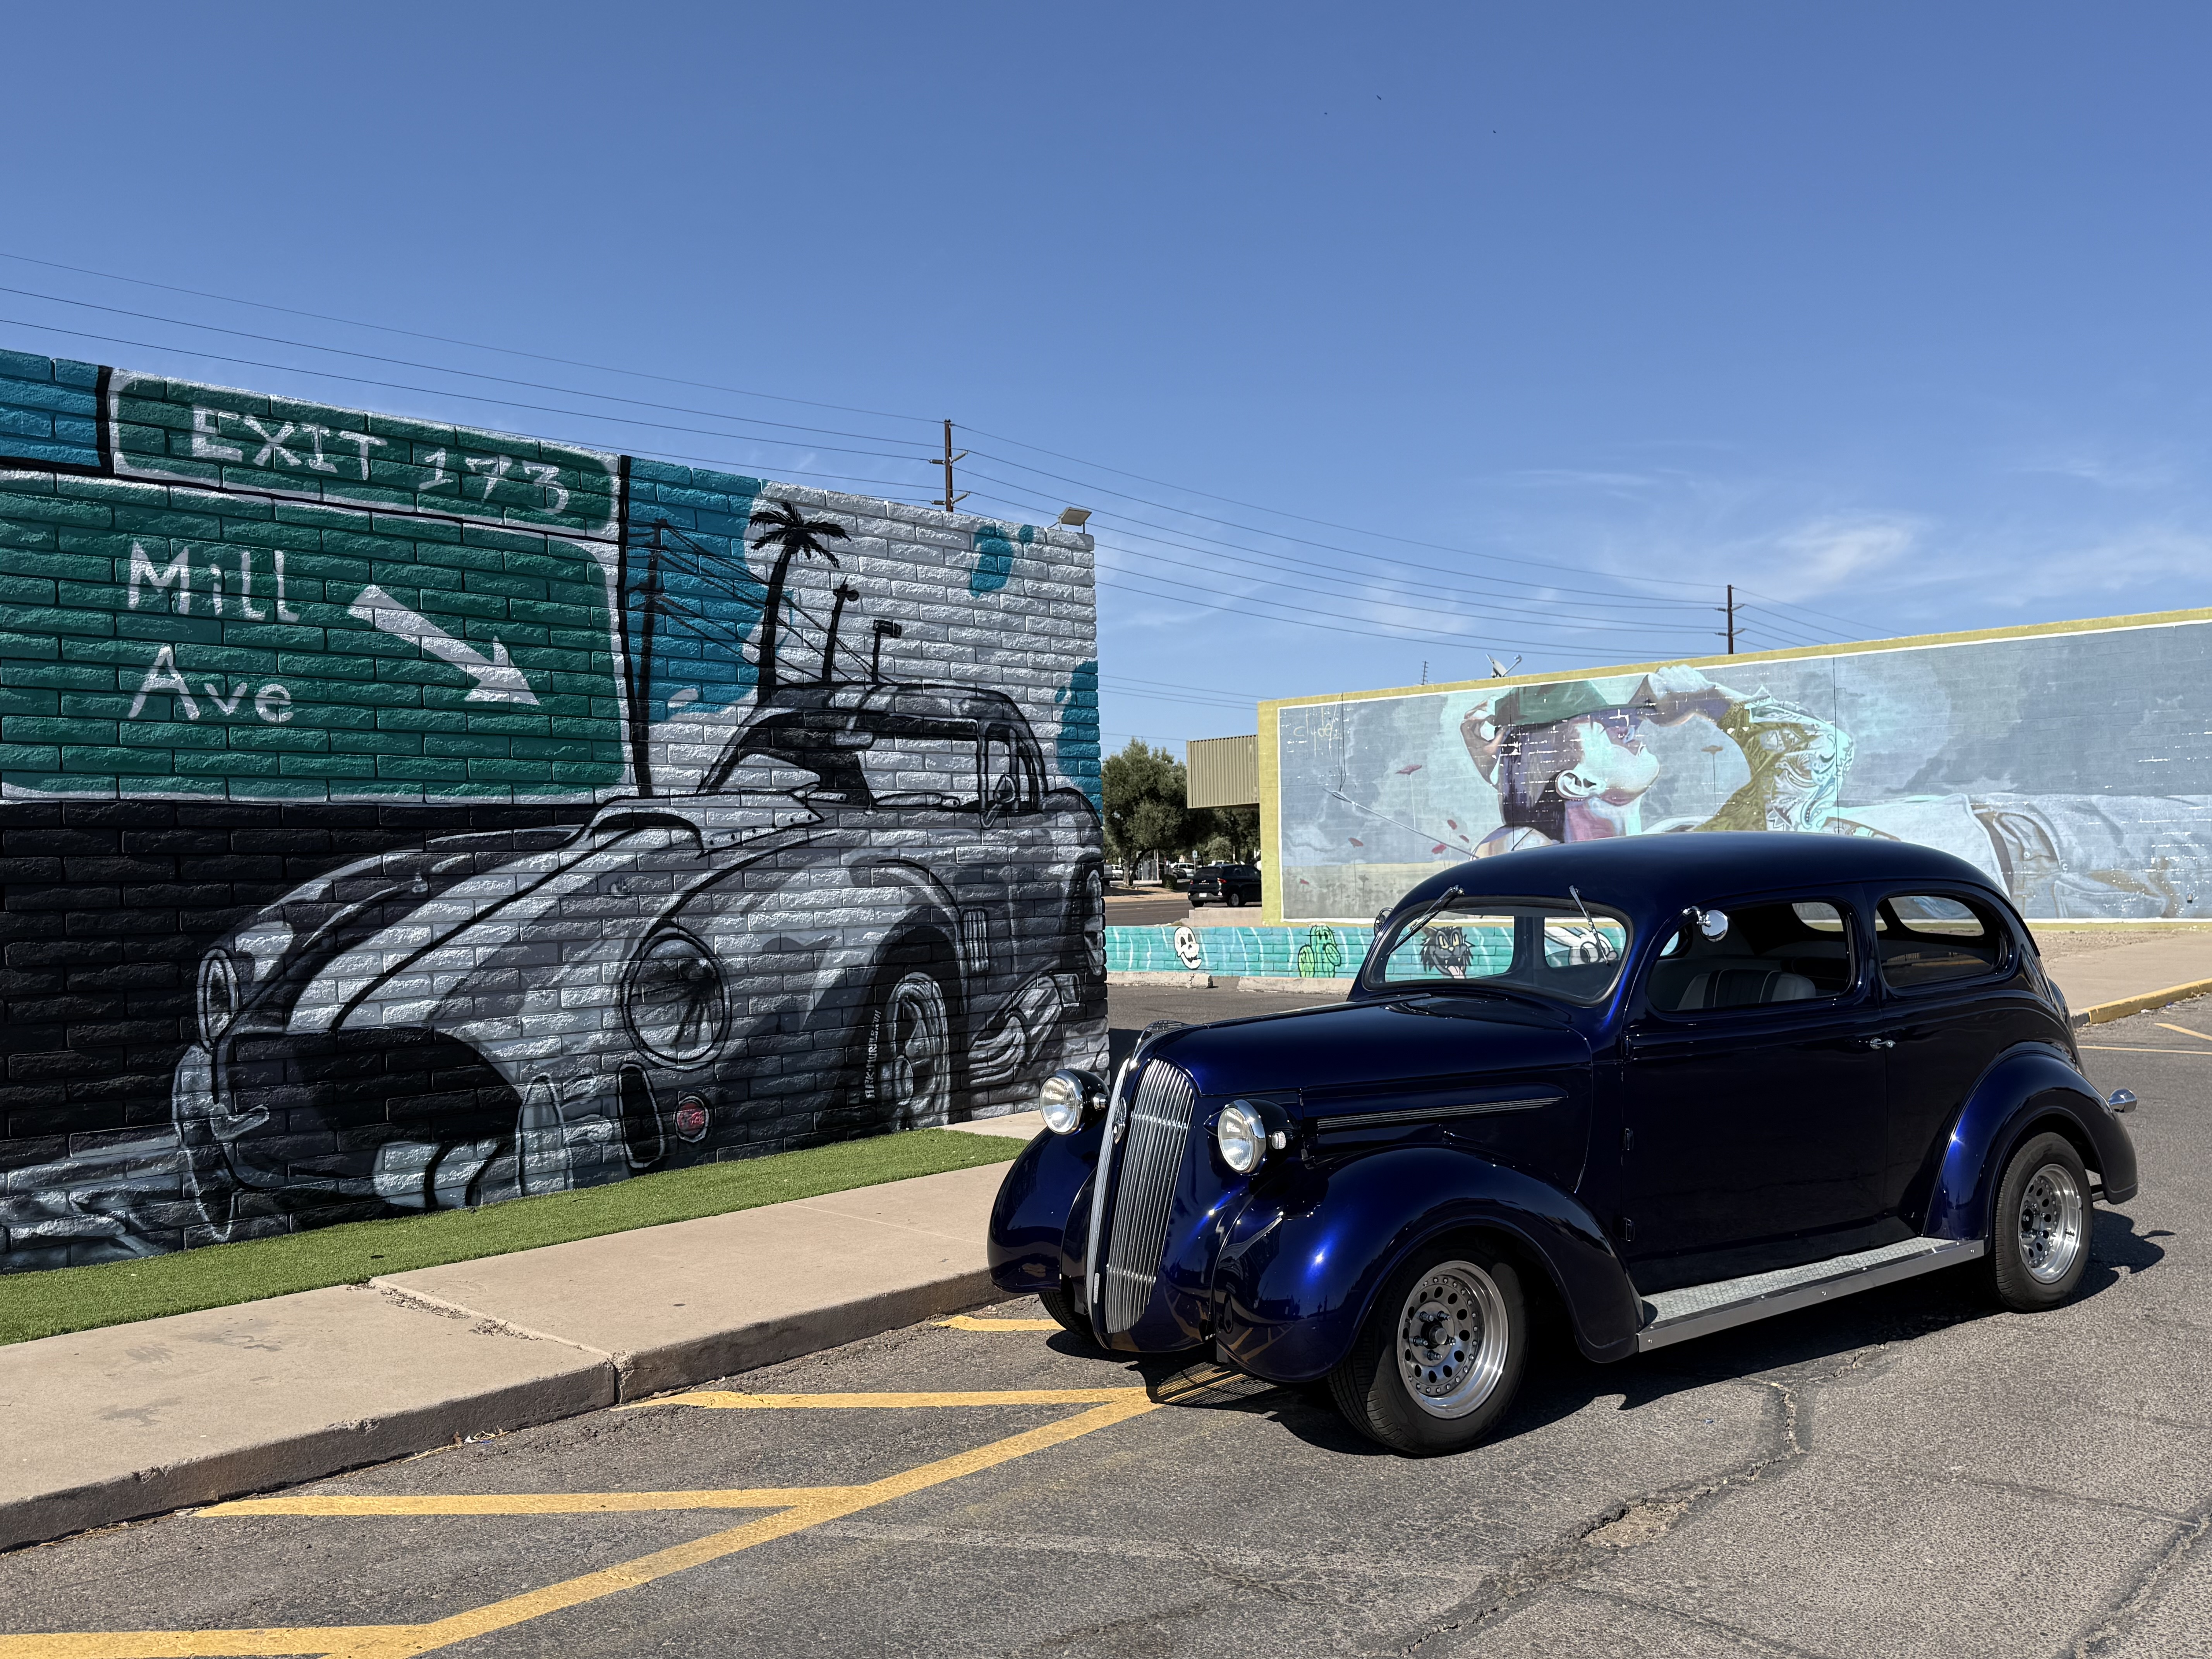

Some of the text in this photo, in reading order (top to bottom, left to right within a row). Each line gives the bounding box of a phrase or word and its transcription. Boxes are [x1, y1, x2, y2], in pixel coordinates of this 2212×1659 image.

[192, 405, 568, 514] EXIT 173
[128, 645, 294, 723] Ave
